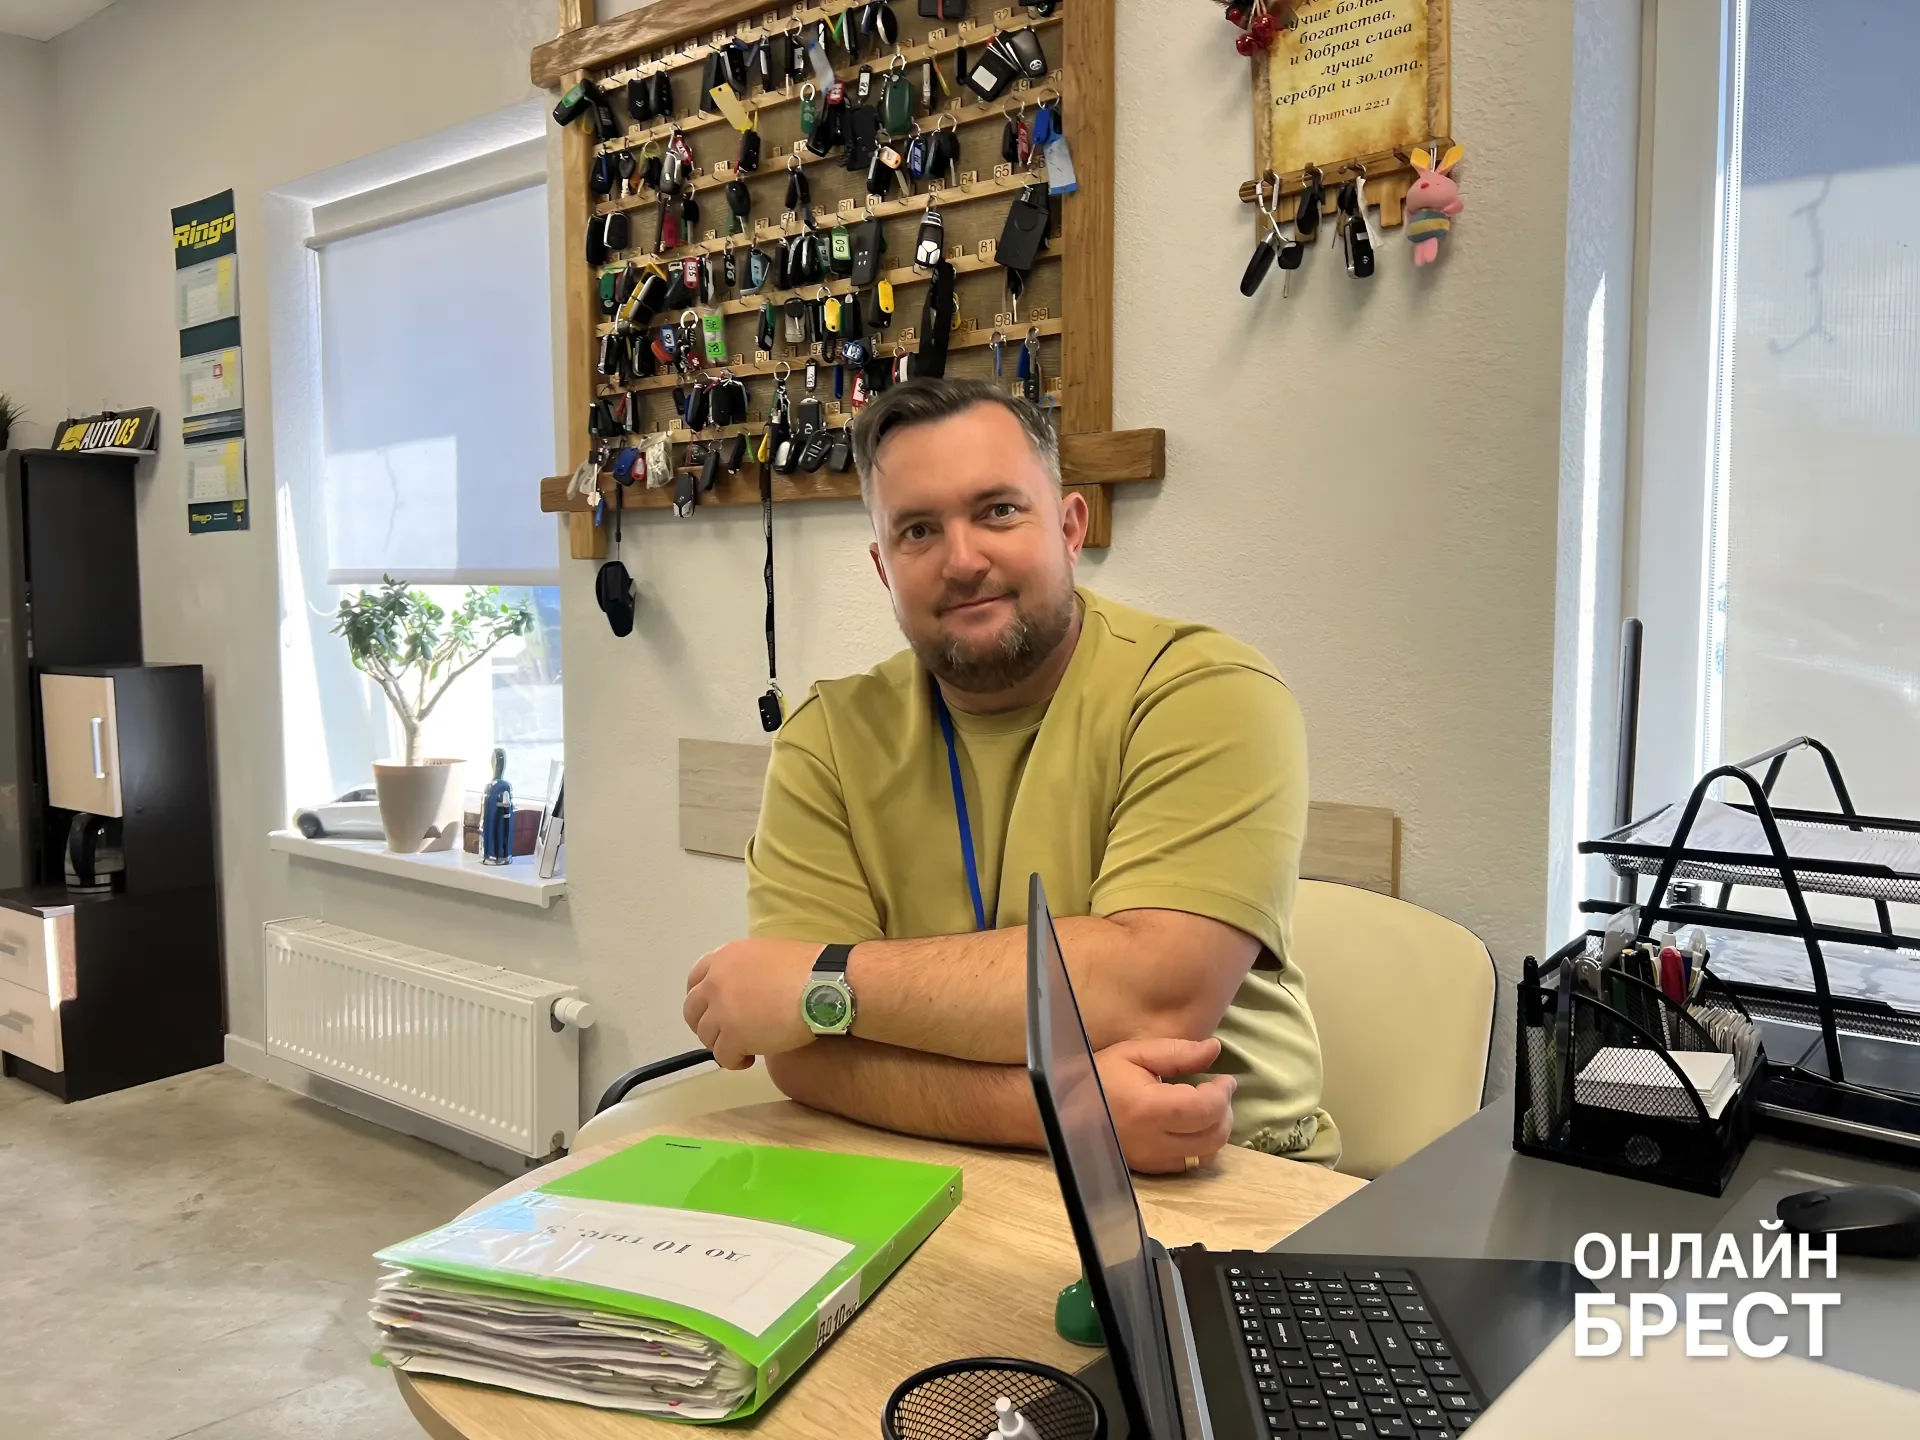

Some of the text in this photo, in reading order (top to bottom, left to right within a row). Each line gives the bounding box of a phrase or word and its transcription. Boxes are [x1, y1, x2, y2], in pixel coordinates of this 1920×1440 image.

[1287, 10, 1331, 32] учше
[1289, 22, 1413, 66] и добрая слава
[1320, 53, 1374, 76] лучше
[1275, 60, 1423, 107] серебра и золота.
[1307, 97, 1391, 126] Притчи 22:1
[995, 166, 1010, 178] 65
[173, 213, 235, 249] Ringo
[980, 240, 995, 253] 81
[996, 314, 1012, 327] 98
[1031, 308, 1047, 322] 99
[900, 329, 914, 341] 95
[652, 1240, 692, 1254] 10
